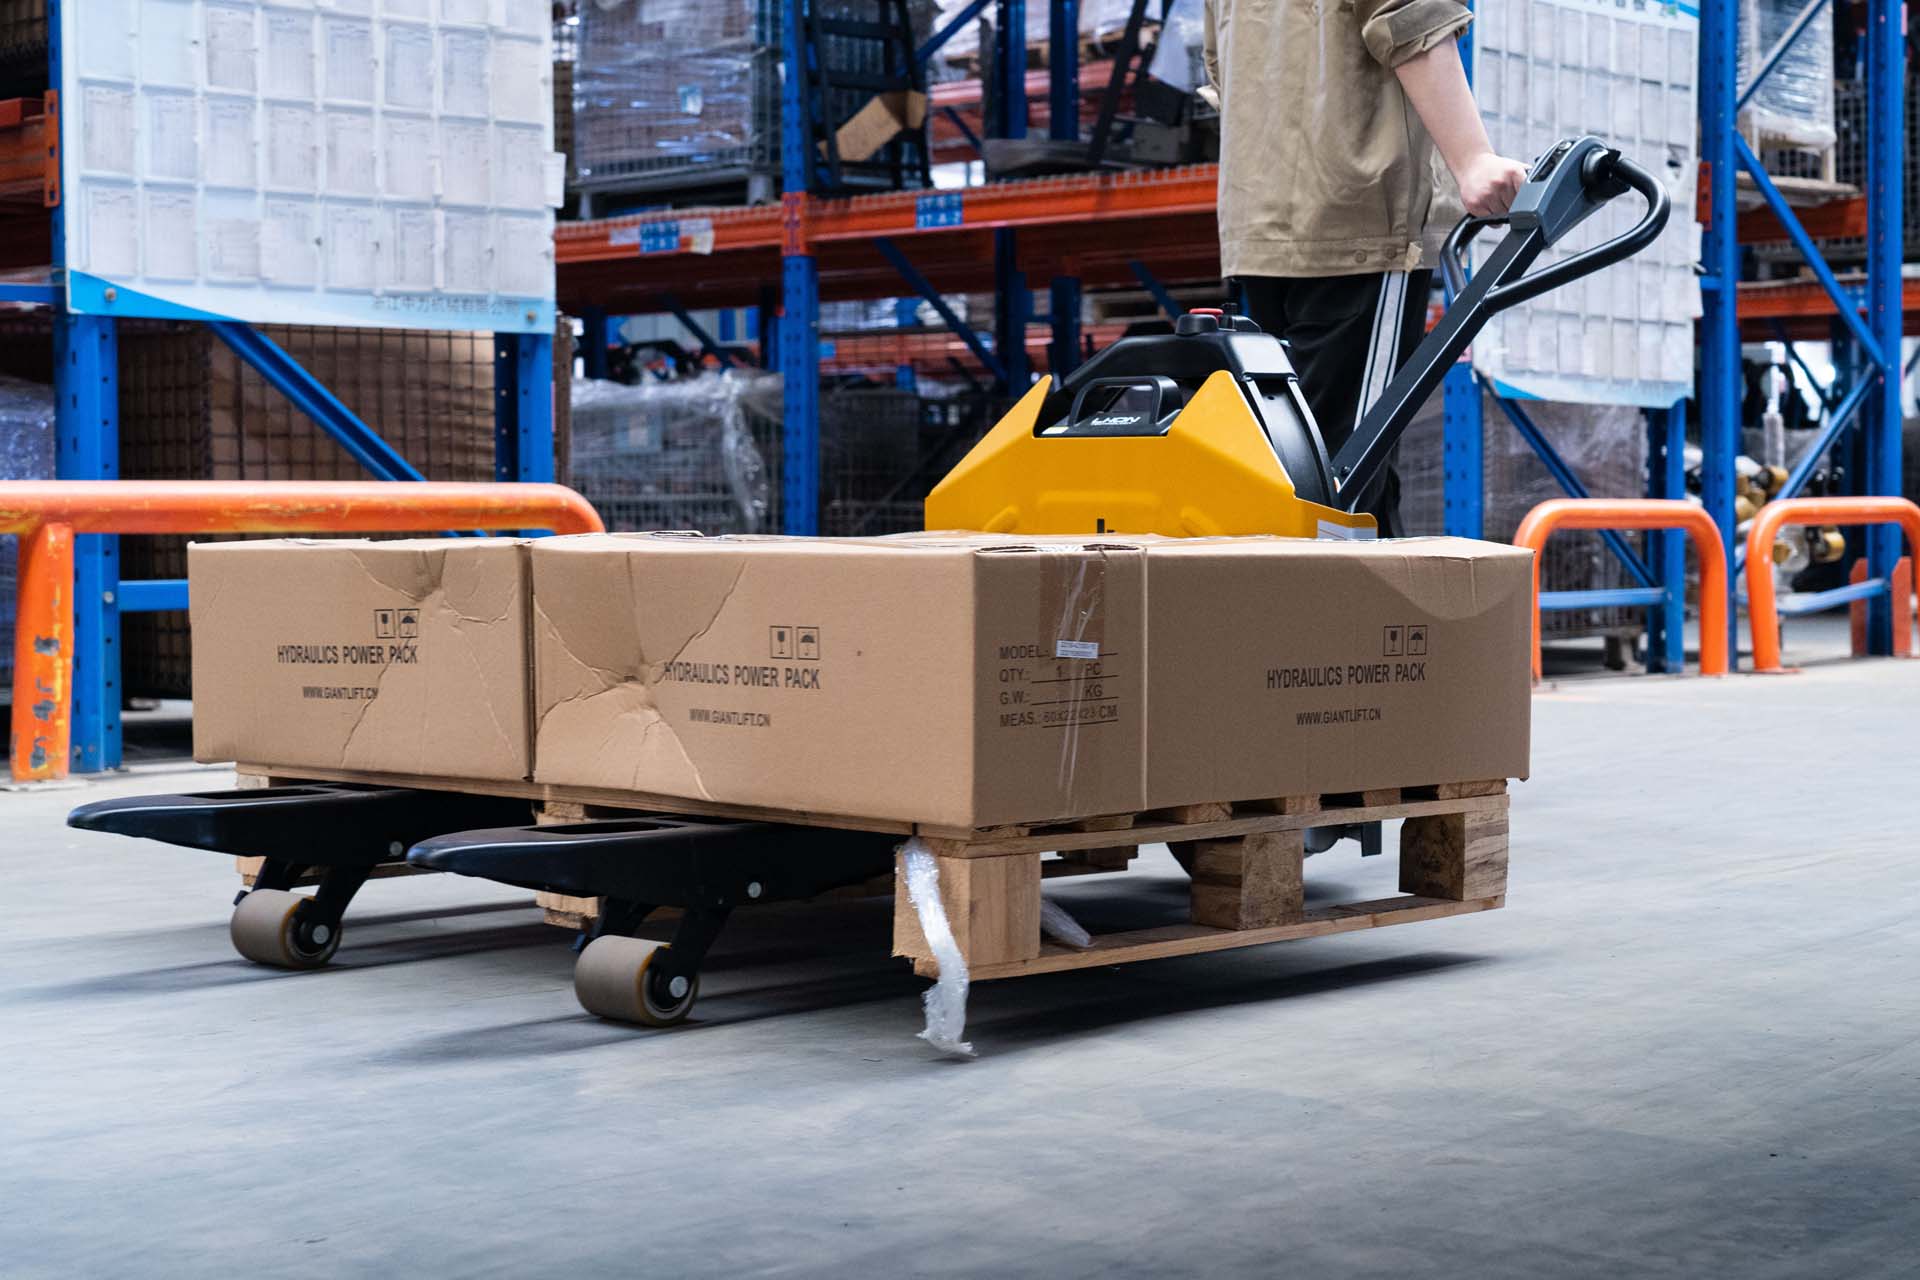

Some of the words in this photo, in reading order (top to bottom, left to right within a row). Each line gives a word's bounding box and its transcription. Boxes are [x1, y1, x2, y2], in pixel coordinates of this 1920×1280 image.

[277, 645, 339, 664] HYDRAULICS
[343, 645, 384, 664] POWER
[389, 645, 418, 664] PACK
[664, 661, 729, 685] HYDRAULICS
[734, 664, 779, 687] POWER
[784, 667, 820, 690] PACK
[1085, 662, 1102, 676] PC
[1267, 666, 1342, 689] HYDRAULICS
[1347, 663, 1390, 685] POWER
[1395, 662, 1426, 682] PACK
[302, 686, 379, 700] WWW.GIANTLIFT.CN
[1085, 684, 1103, 698] KG
[688, 708, 771, 727] WWW.GIANTLIFT.CN
[1099, 705, 1118, 719] CM
[1296, 707, 1382, 726] WWW.GIANTLIFT.CN
